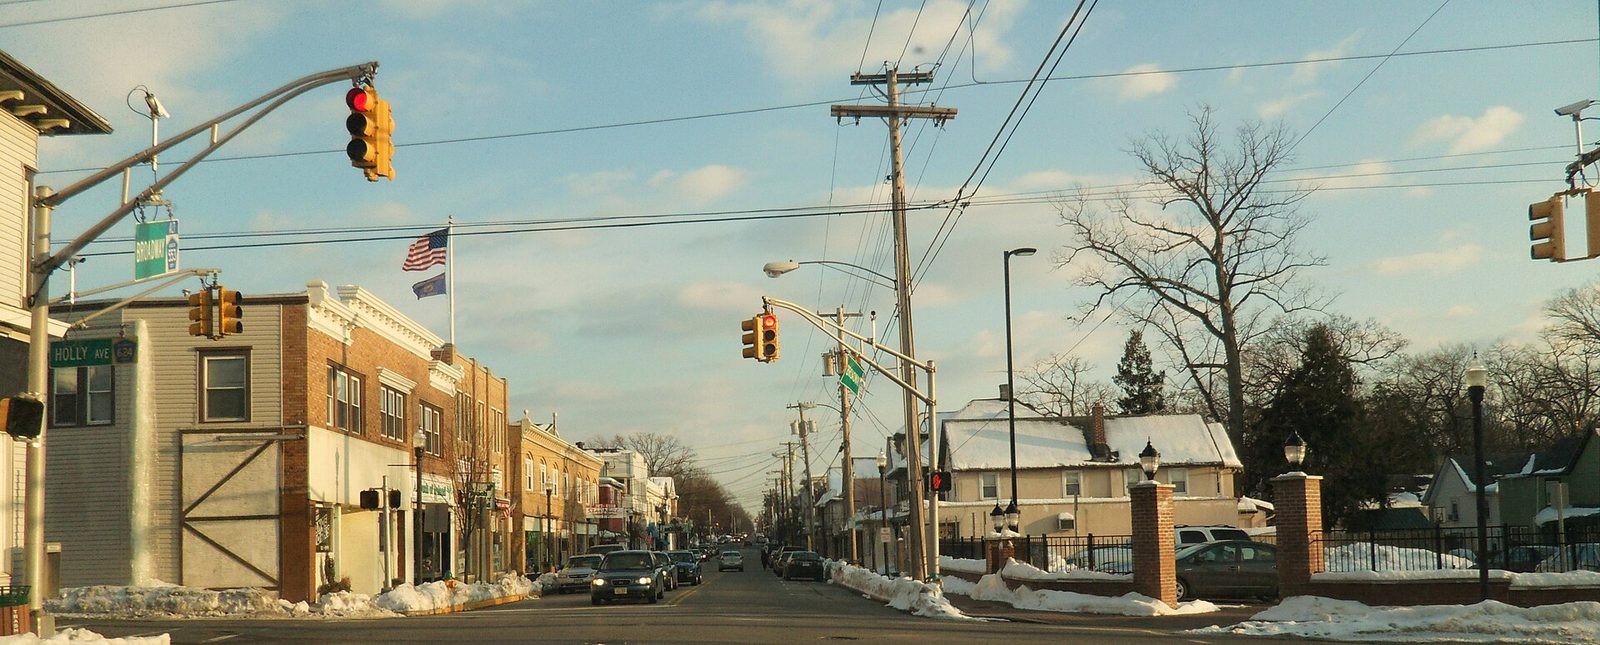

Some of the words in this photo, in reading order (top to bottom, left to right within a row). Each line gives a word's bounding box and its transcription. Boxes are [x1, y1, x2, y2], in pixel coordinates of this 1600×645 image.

[136, 239, 165, 263] BROADWAY
[55, 346, 88, 361] HOLLY
[95, 348, 110, 359] AVE
